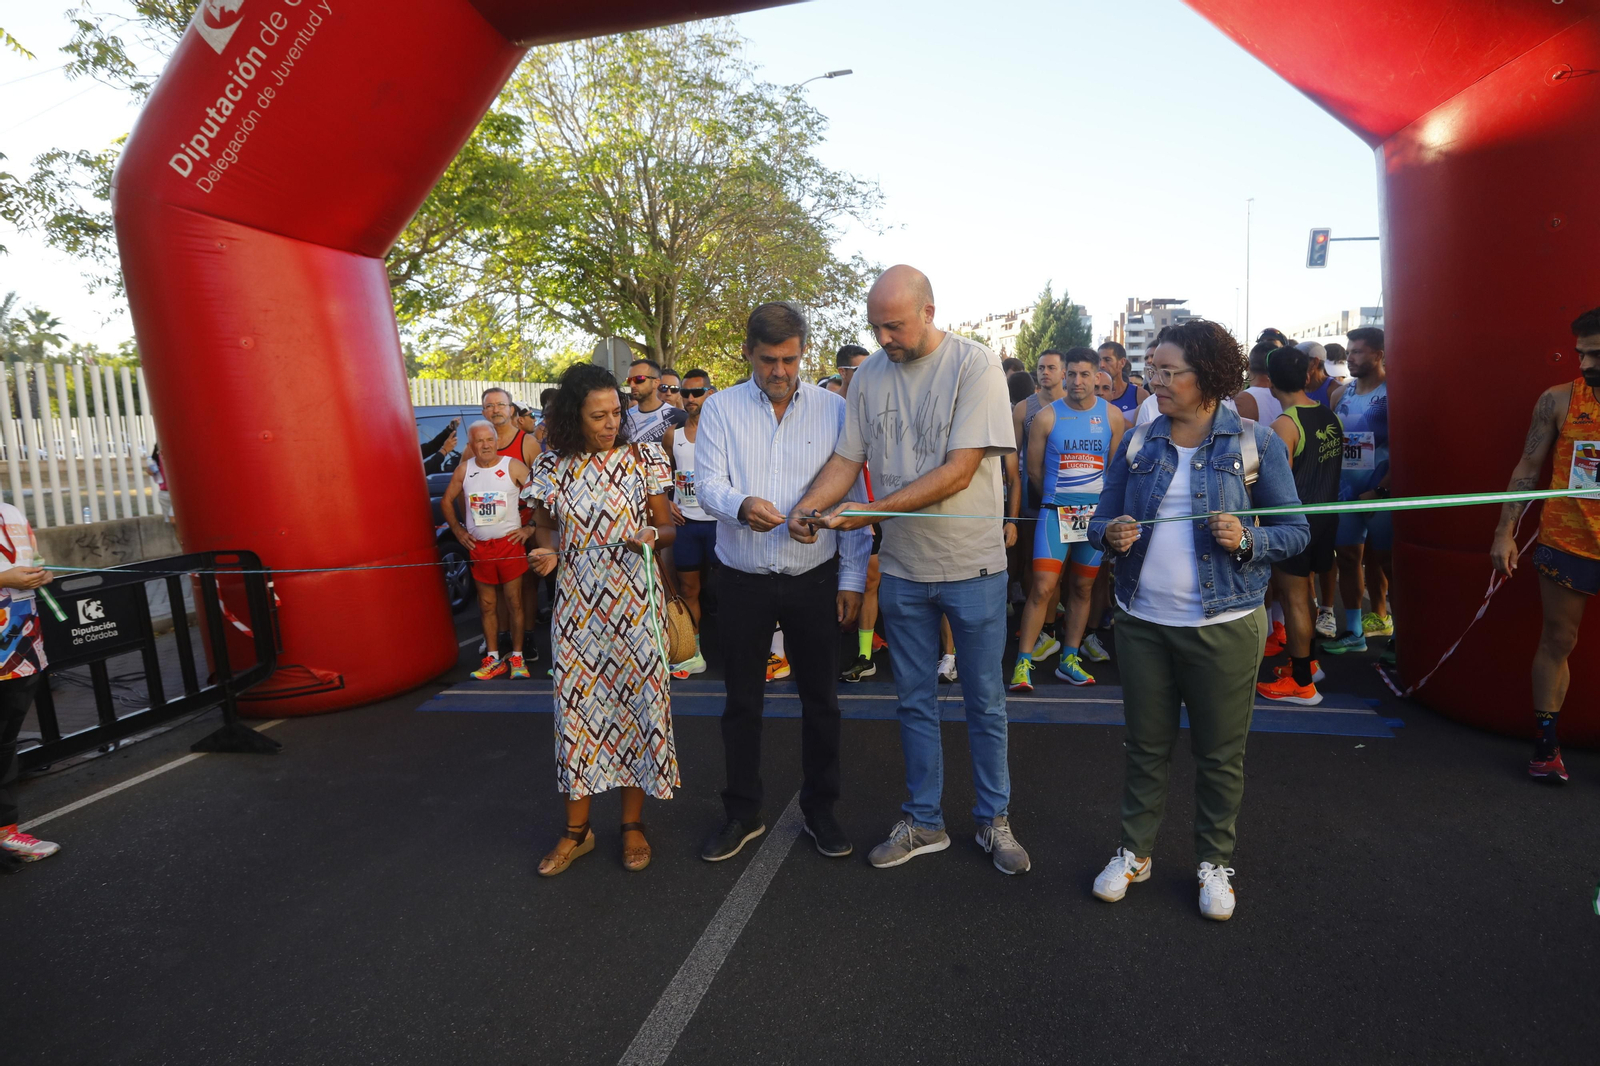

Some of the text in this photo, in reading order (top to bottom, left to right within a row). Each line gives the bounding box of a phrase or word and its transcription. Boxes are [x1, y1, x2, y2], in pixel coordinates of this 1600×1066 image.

[168, 11, 288, 178] Diputación de
[195, 109, 262, 194] Delegación
[257, 86, 276, 109] de
[271, 9, 323, 87] Juventud
[1064, 439, 1102, 451] M.A.REYES
[1064, 453, 1095, 461] Maratón
[1344, 446, 1361, 459] 361
[479, 503, 497, 516] 391
[71, 622, 116, 636] Diputación
[73, 630, 118, 645] de Córdoba
